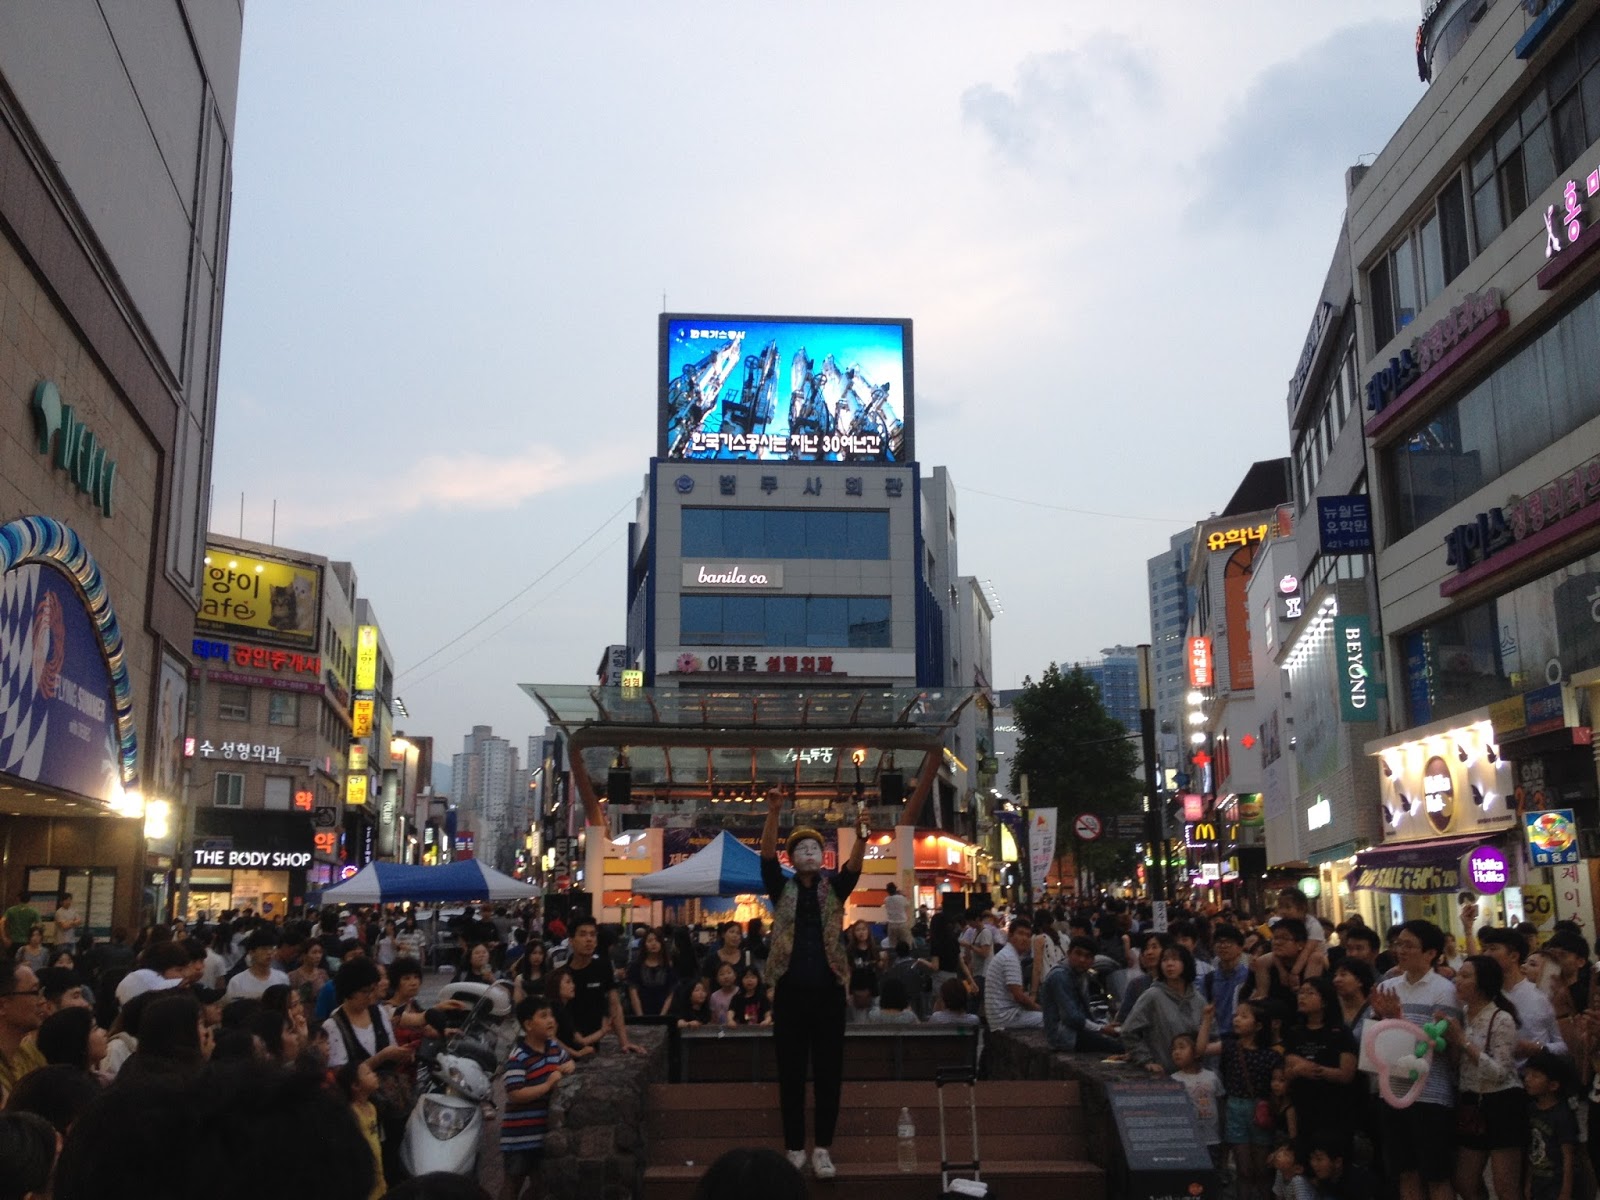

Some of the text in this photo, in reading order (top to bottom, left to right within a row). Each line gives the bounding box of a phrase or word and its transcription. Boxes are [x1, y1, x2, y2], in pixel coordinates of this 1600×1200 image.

[692, 432, 881, 454] 한국가스공사는 지난 30여년간
[1323, 503, 1368, 520] 뉴월드
[1325, 519, 1369, 535] 유학원
[204, 567, 259, 599] 양이
[697, 565, 768, 585] banila co.
[198, 597, 256, 620] afe
[235, 642, 321, 676] 공인중개사
[707, 655, 834, 674] 이동훈 성형외과
[1345, 627, 1368, 710] BEYOND
[199, 739, 215, 757] 수
[220, 741, 282, 763] 성형외과
[294, 789, 314, 812] 약
[314, 832, 335, 856] 약
[194, 849, 312, 867] THE BODY SHOP
[1471, 857, 1504, 871] Holika
[1375, 866, 1405, 889] SALE
[1473, 870, 1505, 883] Holika
[1524, 894, 1551, 914] 50
